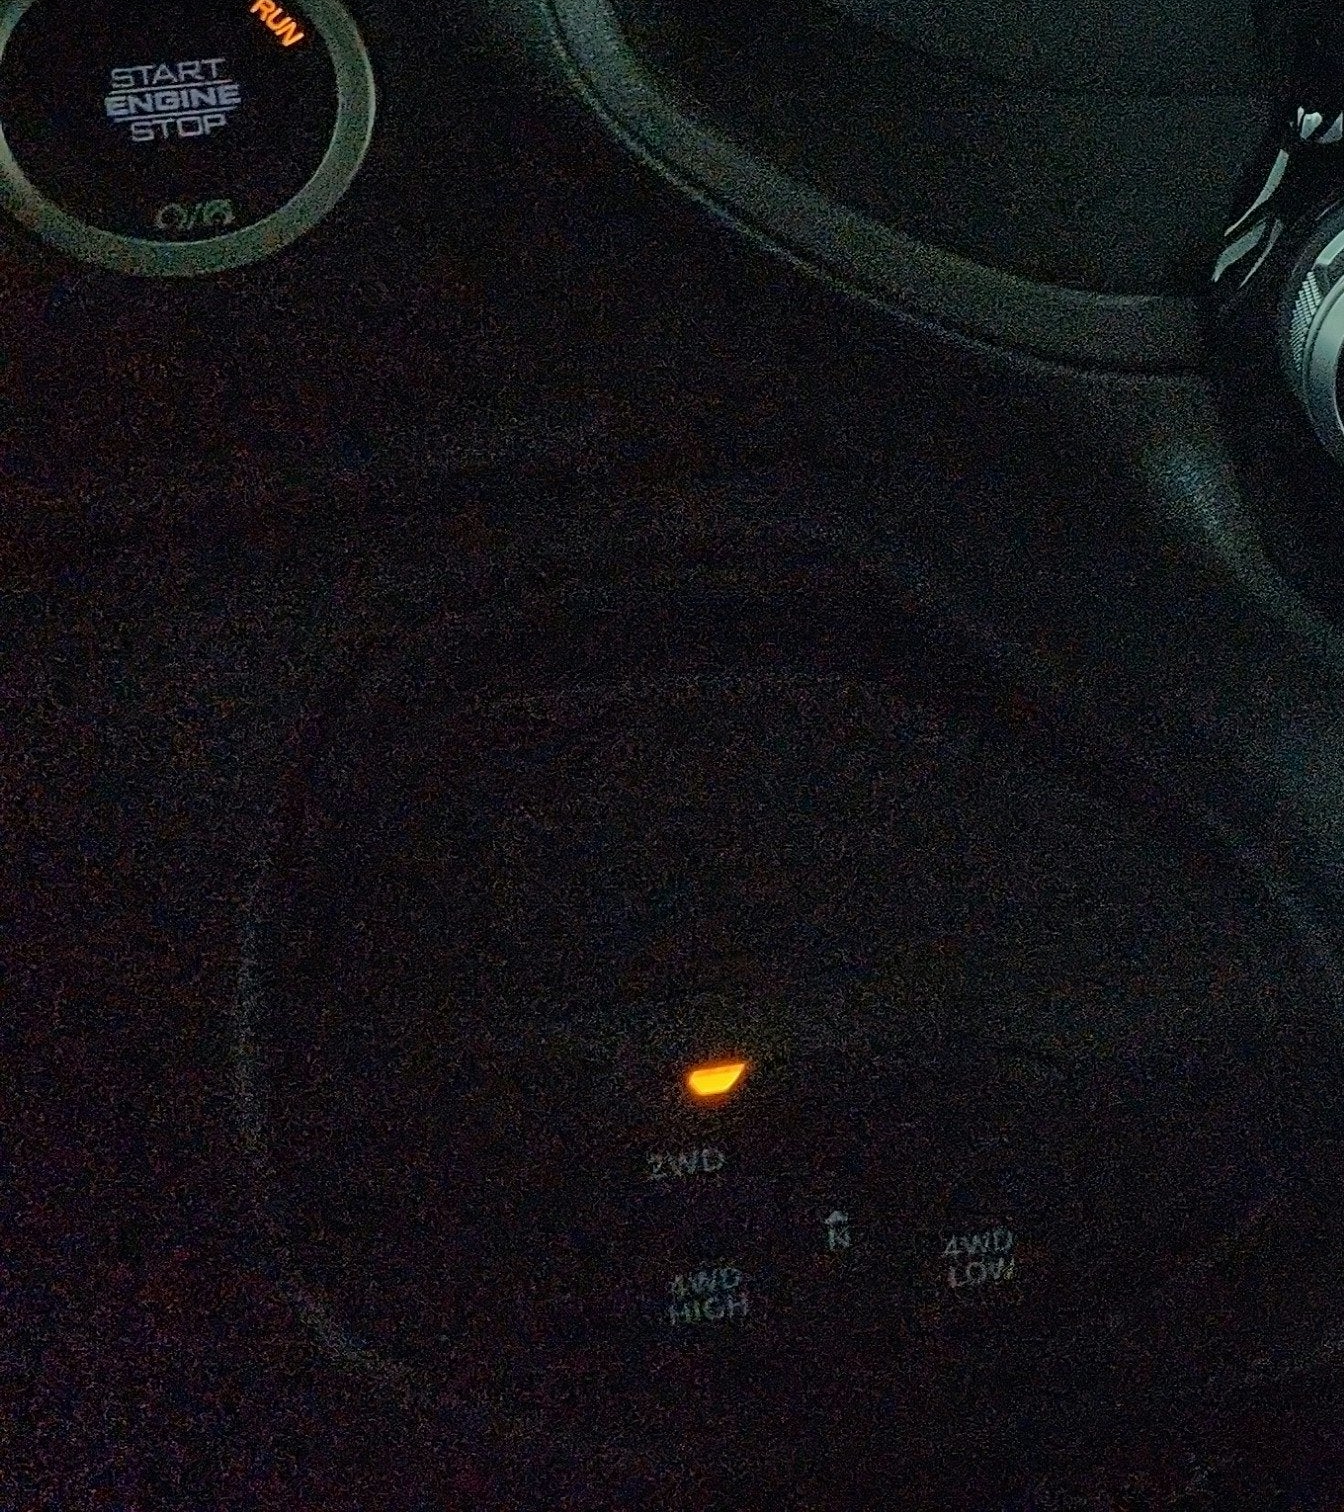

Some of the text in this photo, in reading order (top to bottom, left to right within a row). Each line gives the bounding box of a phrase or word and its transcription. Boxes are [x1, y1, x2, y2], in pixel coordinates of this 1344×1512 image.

[111, 58, 226, 88] START
[105, 84, 242, 116] ENGINE
[131, 113, 227, 142] STOP
[647, 1150, 725, 1179] 2WD
[943, 1228, 1015, 1259] 4WD
[670, 1268, 741, 1297] 4WD
[948, 1257, 1017, 1287] LOW
[668, 1294, 749, 1325] HIGH
